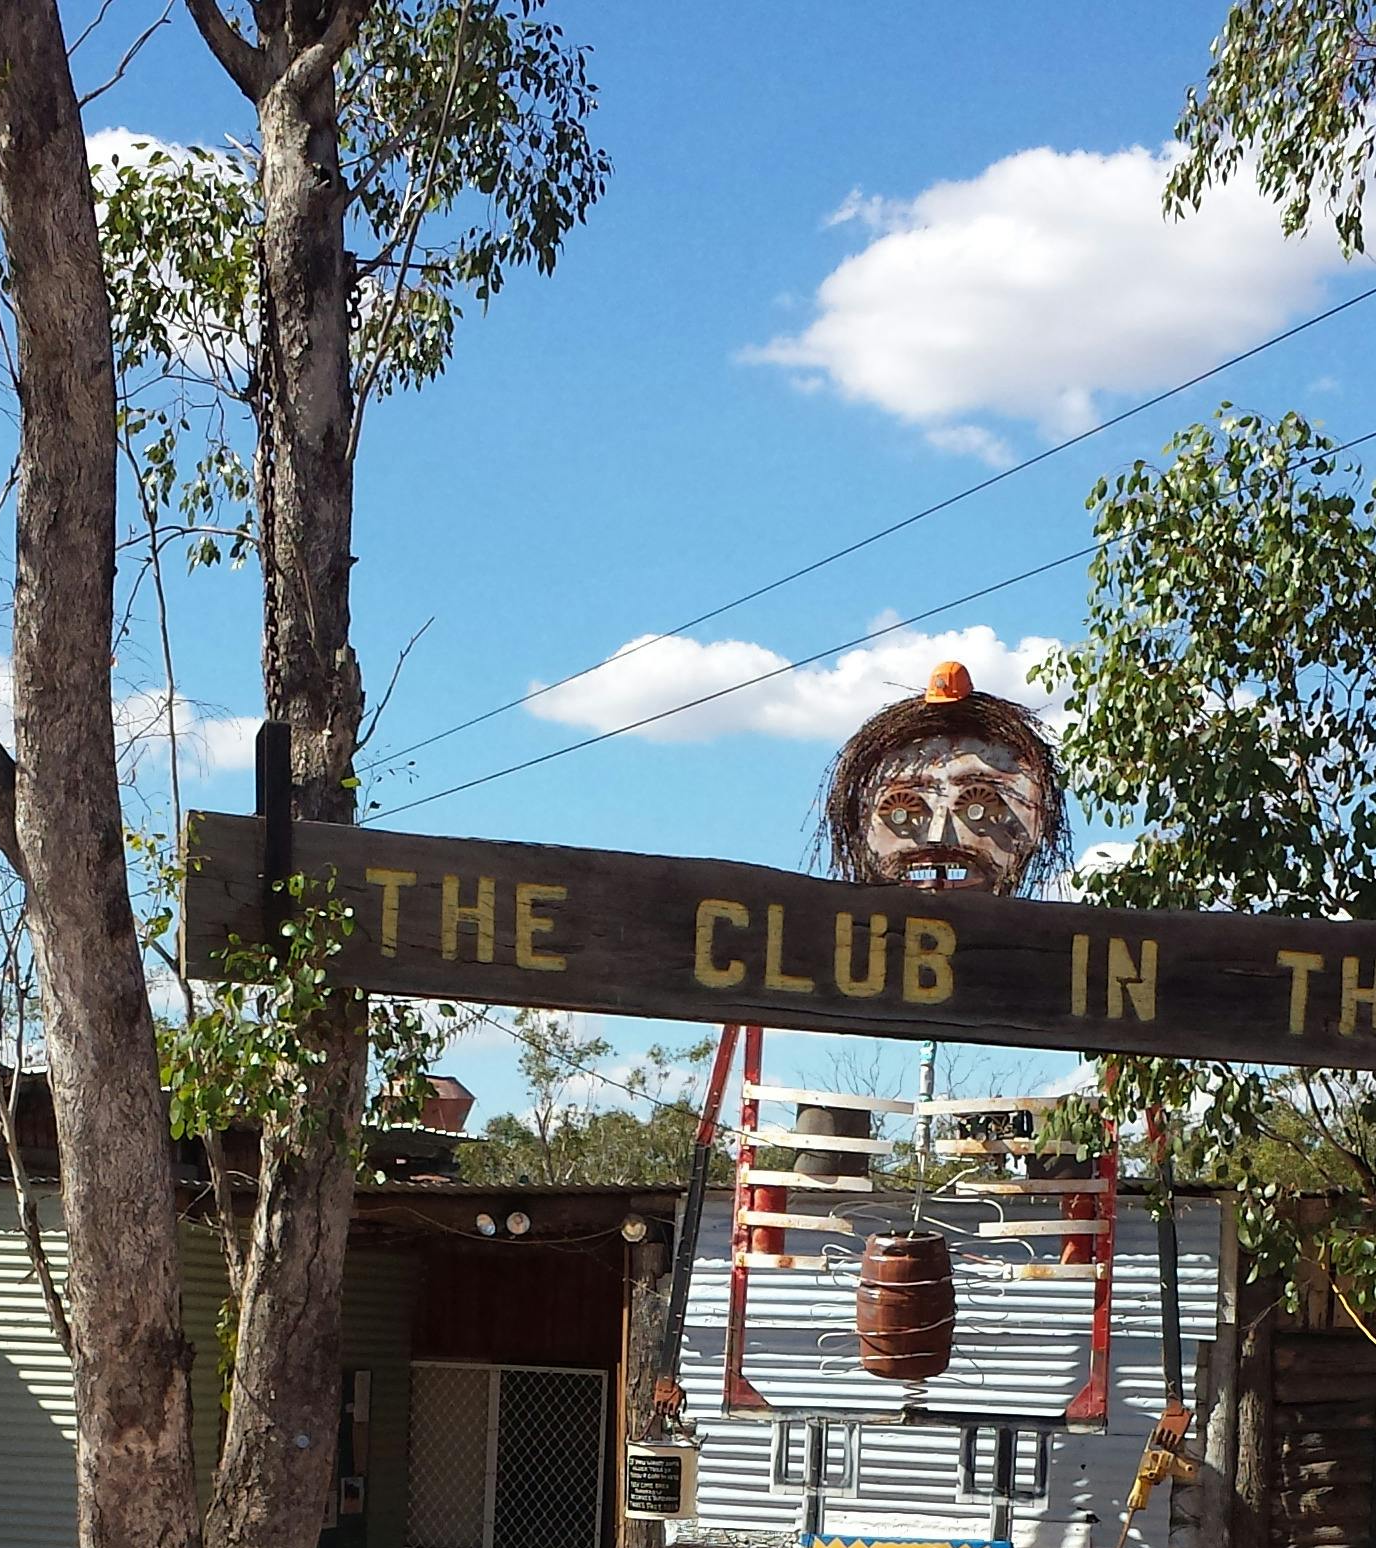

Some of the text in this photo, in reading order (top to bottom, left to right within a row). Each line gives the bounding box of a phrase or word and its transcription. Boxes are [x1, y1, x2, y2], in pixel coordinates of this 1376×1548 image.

[365, 867, 569, 972] THE
[693, 897, 958, 1005] CLUB
[1070, 933, 1159, 1022] IN
